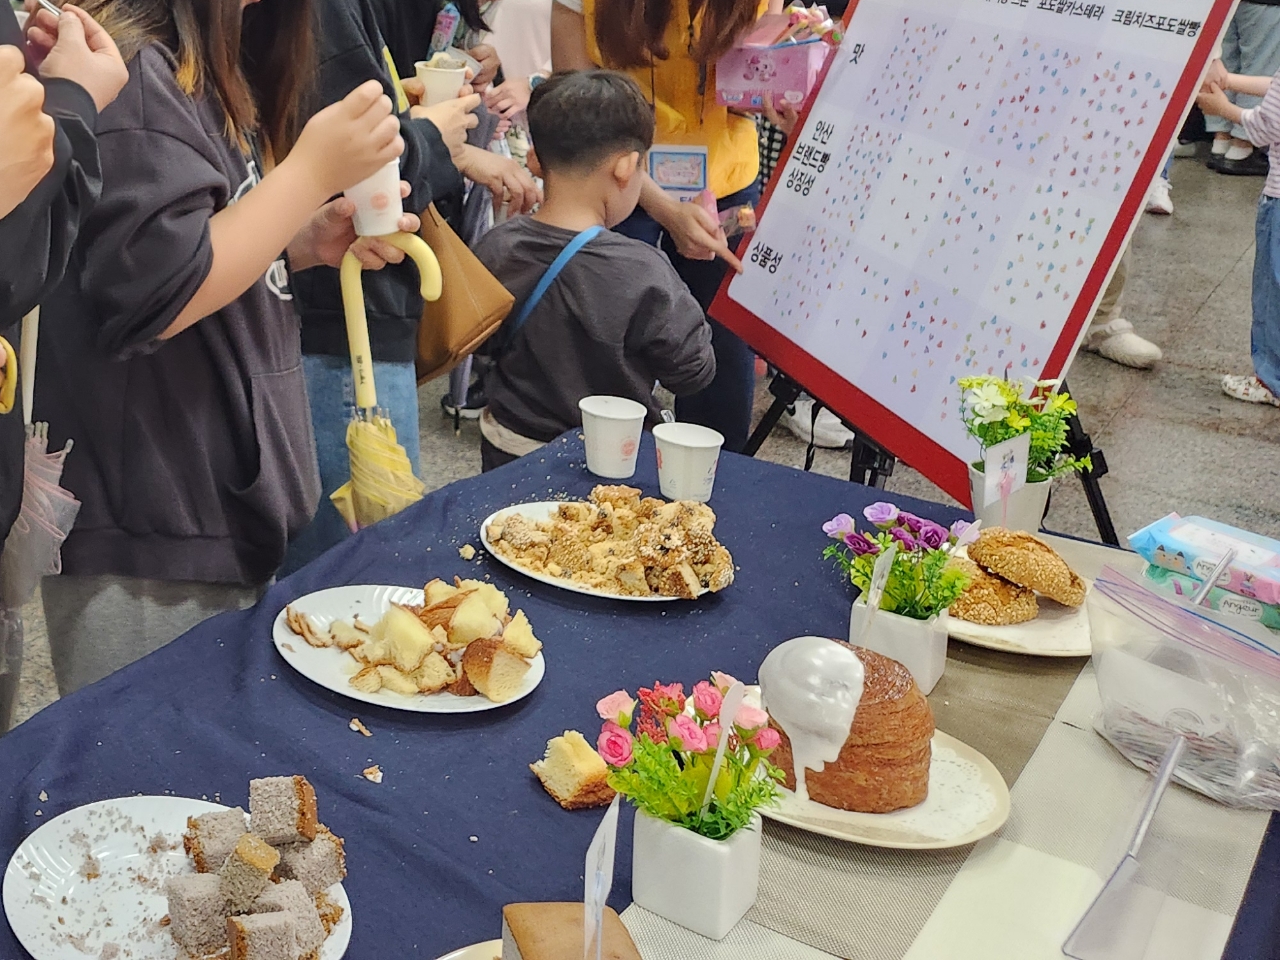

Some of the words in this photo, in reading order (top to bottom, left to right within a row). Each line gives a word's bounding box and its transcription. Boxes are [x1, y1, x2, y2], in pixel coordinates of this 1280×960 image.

[1112, 9, 1201, 38] 크림치즈포도쌀빵
[849, 42, 866, 65] 맛
[812, 119, 835, 145] 안산
[792, 142, 831, 174] 브랜드빵
[786, 167, 816, 197] 상징성
[750, 240, 783, 275] 상품성
